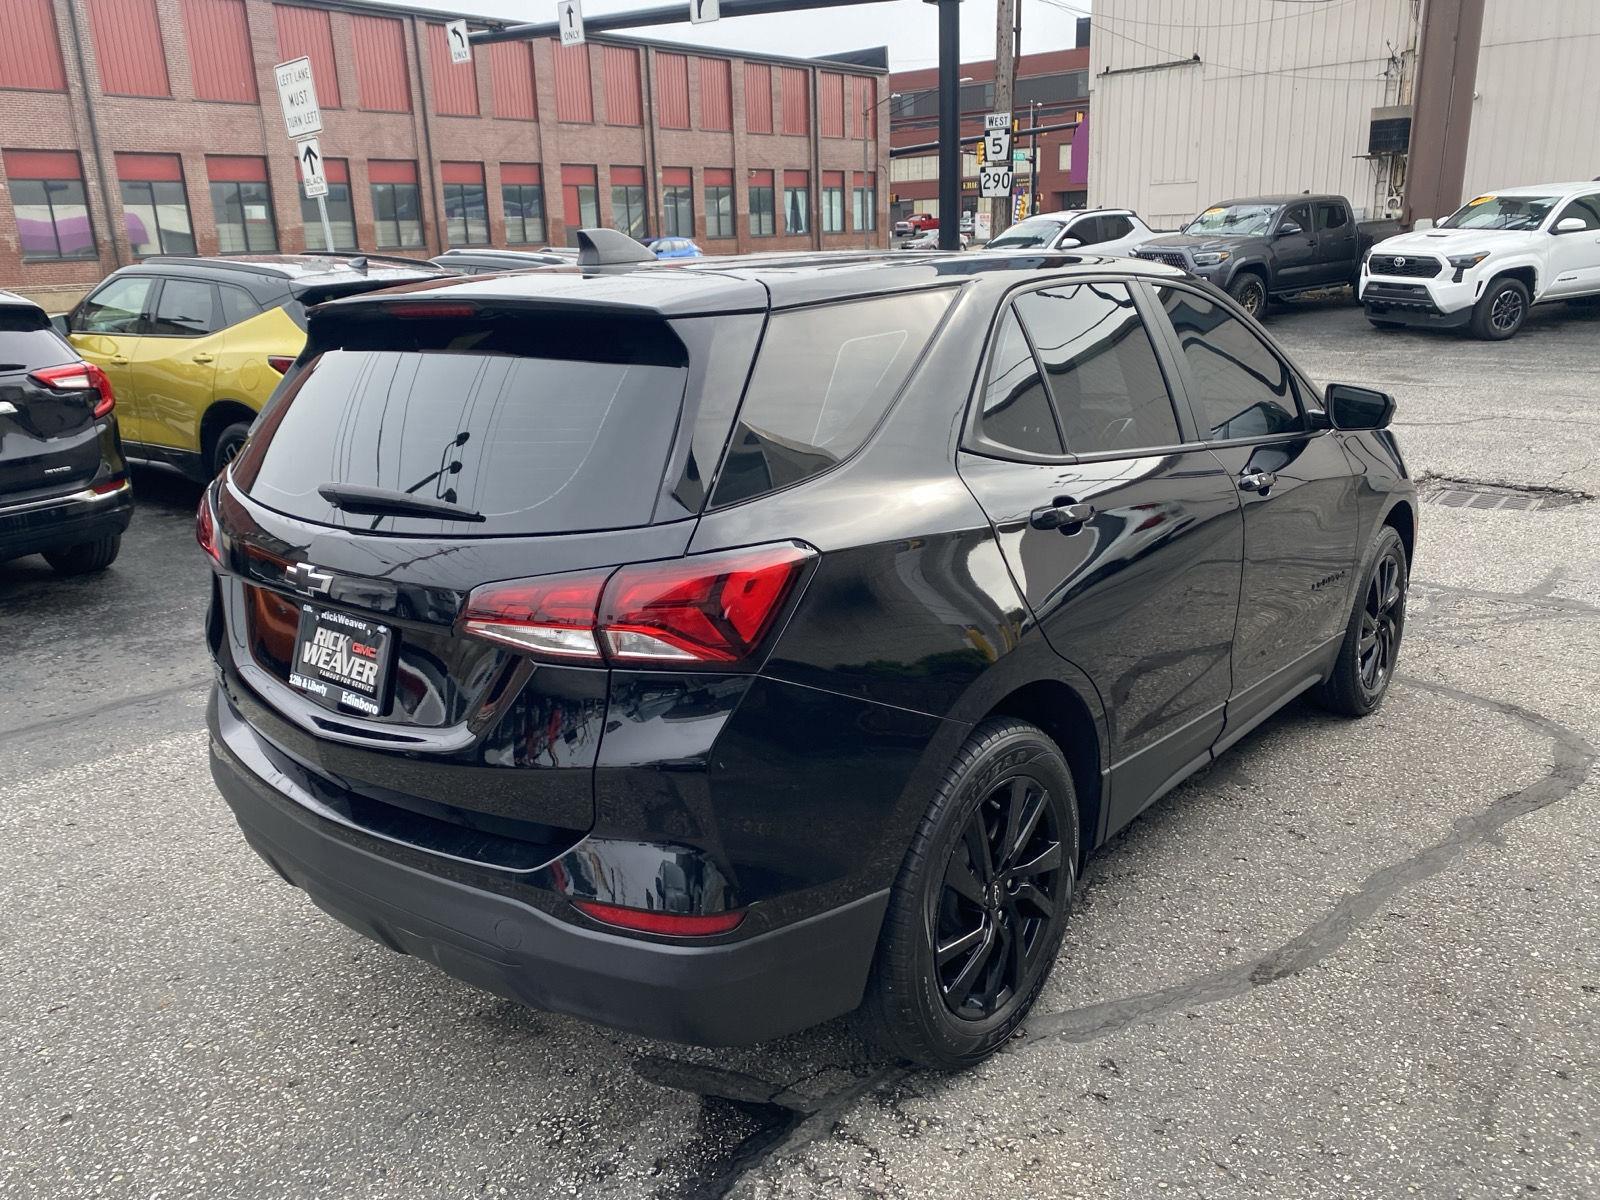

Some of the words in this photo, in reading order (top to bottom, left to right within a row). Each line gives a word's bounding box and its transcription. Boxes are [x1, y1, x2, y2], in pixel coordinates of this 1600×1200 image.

[563, 29, 580, 41] ONLY
[454, 49, 468, 60] ONLY
[278, 72, 293, 87] LEFT
[294, 67, 310, 83] LANE
[288, 90, 309, 106] MUST
[287, 114, 303, 129] TURN
[304, 110, 319, 125] LEFT
[987, 116, 1009, 127] WEST
[991, 137, 1003, 155] 5
[982, 172, 1010, 190] 290
[313, 626, 351, 652] RICK
[352, 642, 377, 658] GMC
[302, 641, 379, 686] WEAVER
[303, 677, 309, 688] &
[308, 679, 328, 697] Liberty
[319, 669, 340, 681] FAMOUS
[340, 676, 351, 685] FOR
[351, 680, 374, 693] SERVICE
[341, 691, 379, 715] Edinboro
